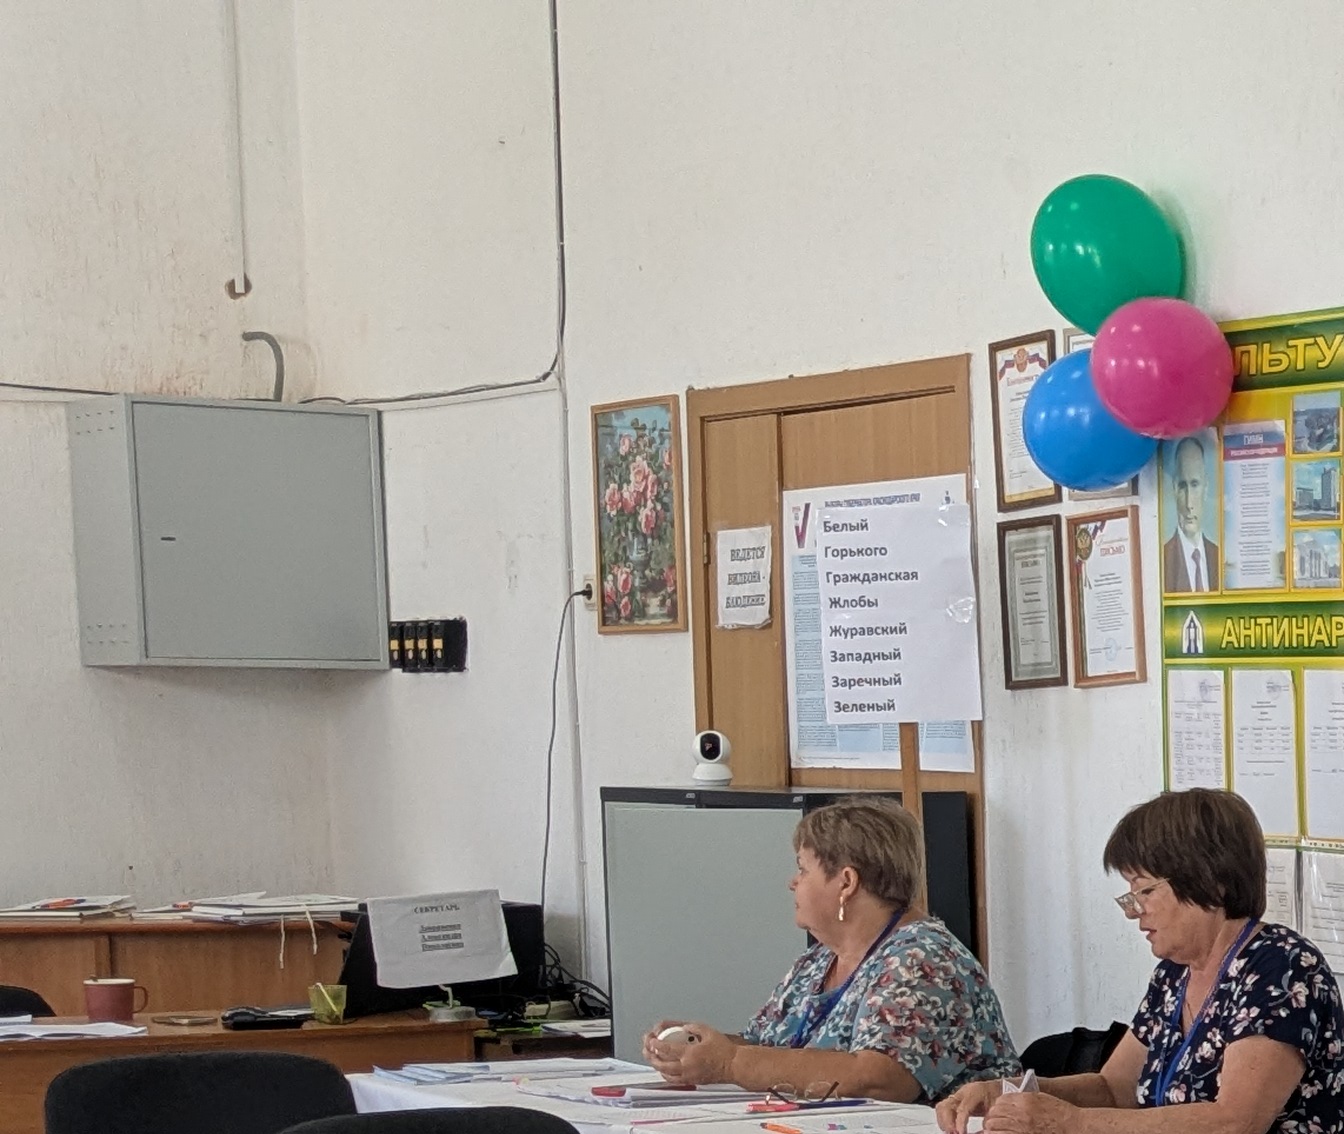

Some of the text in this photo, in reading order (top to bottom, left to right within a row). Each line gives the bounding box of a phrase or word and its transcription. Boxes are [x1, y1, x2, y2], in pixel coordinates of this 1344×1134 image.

[823, 518, 869, 533] Белый
[824, 546, 888, 559] Горького
[826, 570, 919, 584] Гражданская
[828, 596, 878, 609] Жлобы
[829, 622, 908, 639] Журавский
[830, 648, 902, 664] Западный
[831, 673, 902, 690] Заречный
[833, 699, 896, 714] Зеленый
